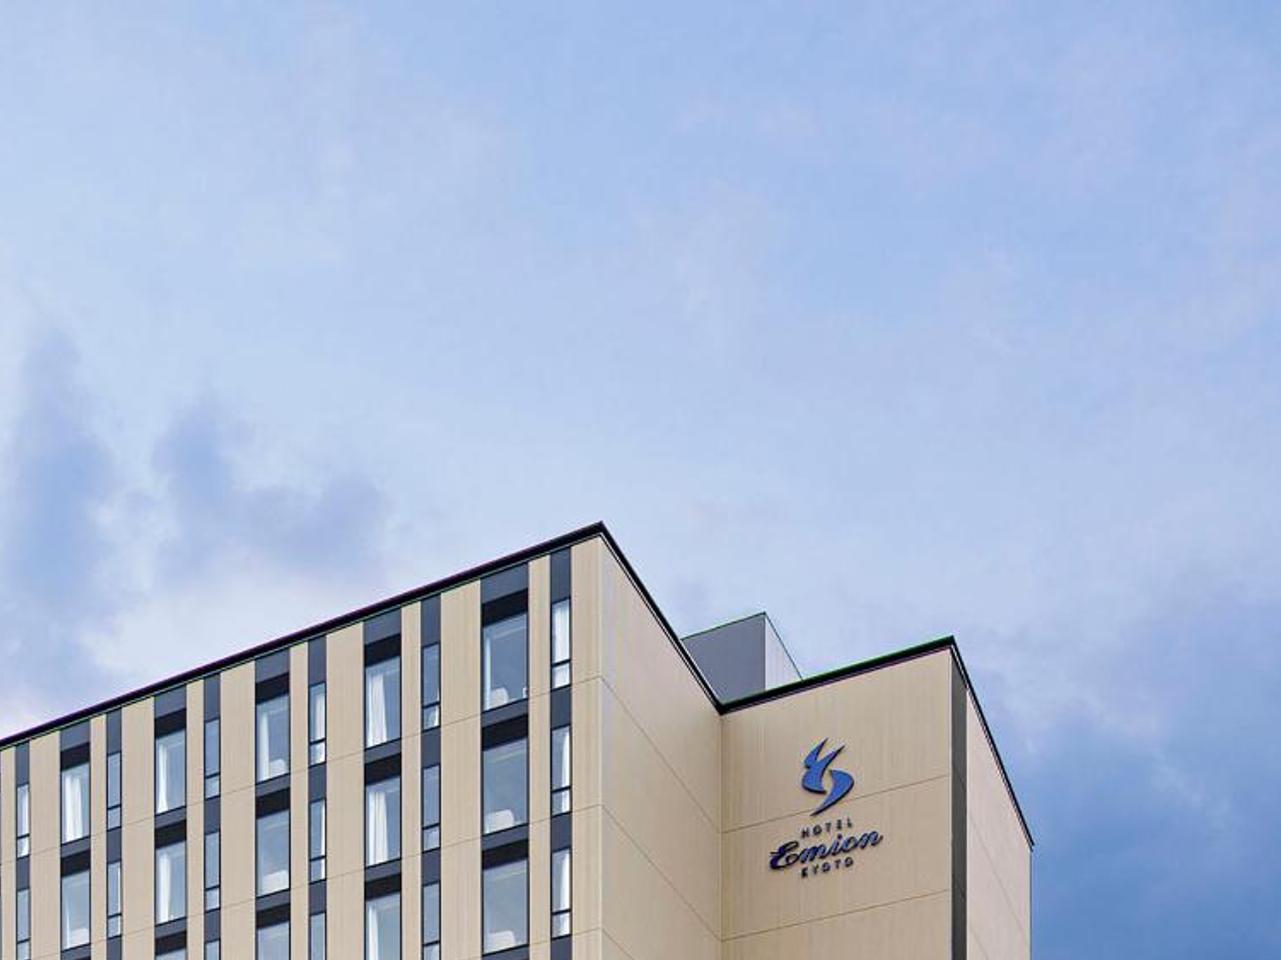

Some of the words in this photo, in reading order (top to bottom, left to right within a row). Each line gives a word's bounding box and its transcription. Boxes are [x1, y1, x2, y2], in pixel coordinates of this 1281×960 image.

[801, 817, 853, 838] HOTEL
[769, 830, 884, 870] Emion
[801, 856, 854, 878] KYOTO
